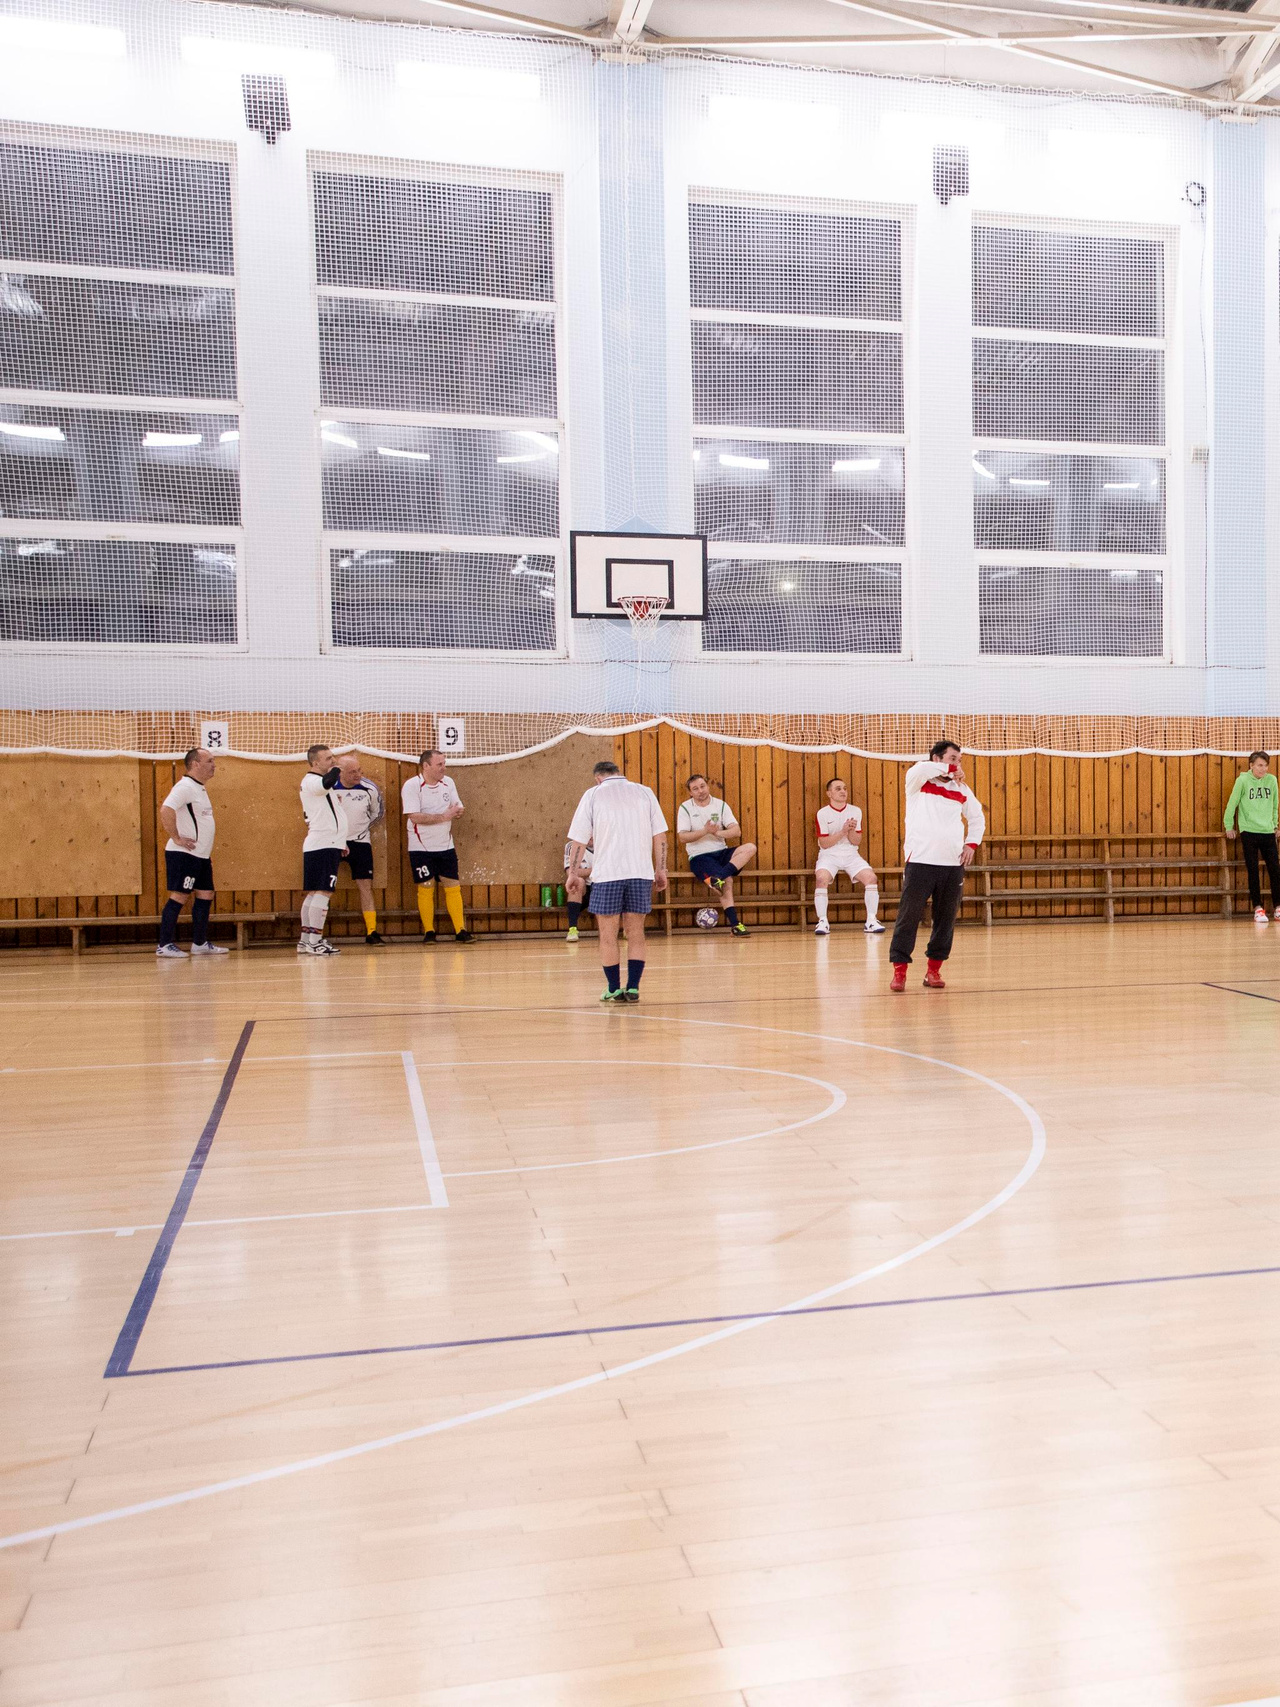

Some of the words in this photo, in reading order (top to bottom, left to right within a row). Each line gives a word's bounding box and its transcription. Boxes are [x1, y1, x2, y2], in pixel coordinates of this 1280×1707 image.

[207, 730, 222, 748] 8
[445, 727, 459, 746] 9
[1249, 787, 1271, 800] GAP
[416, 865, 430, 879] 79
